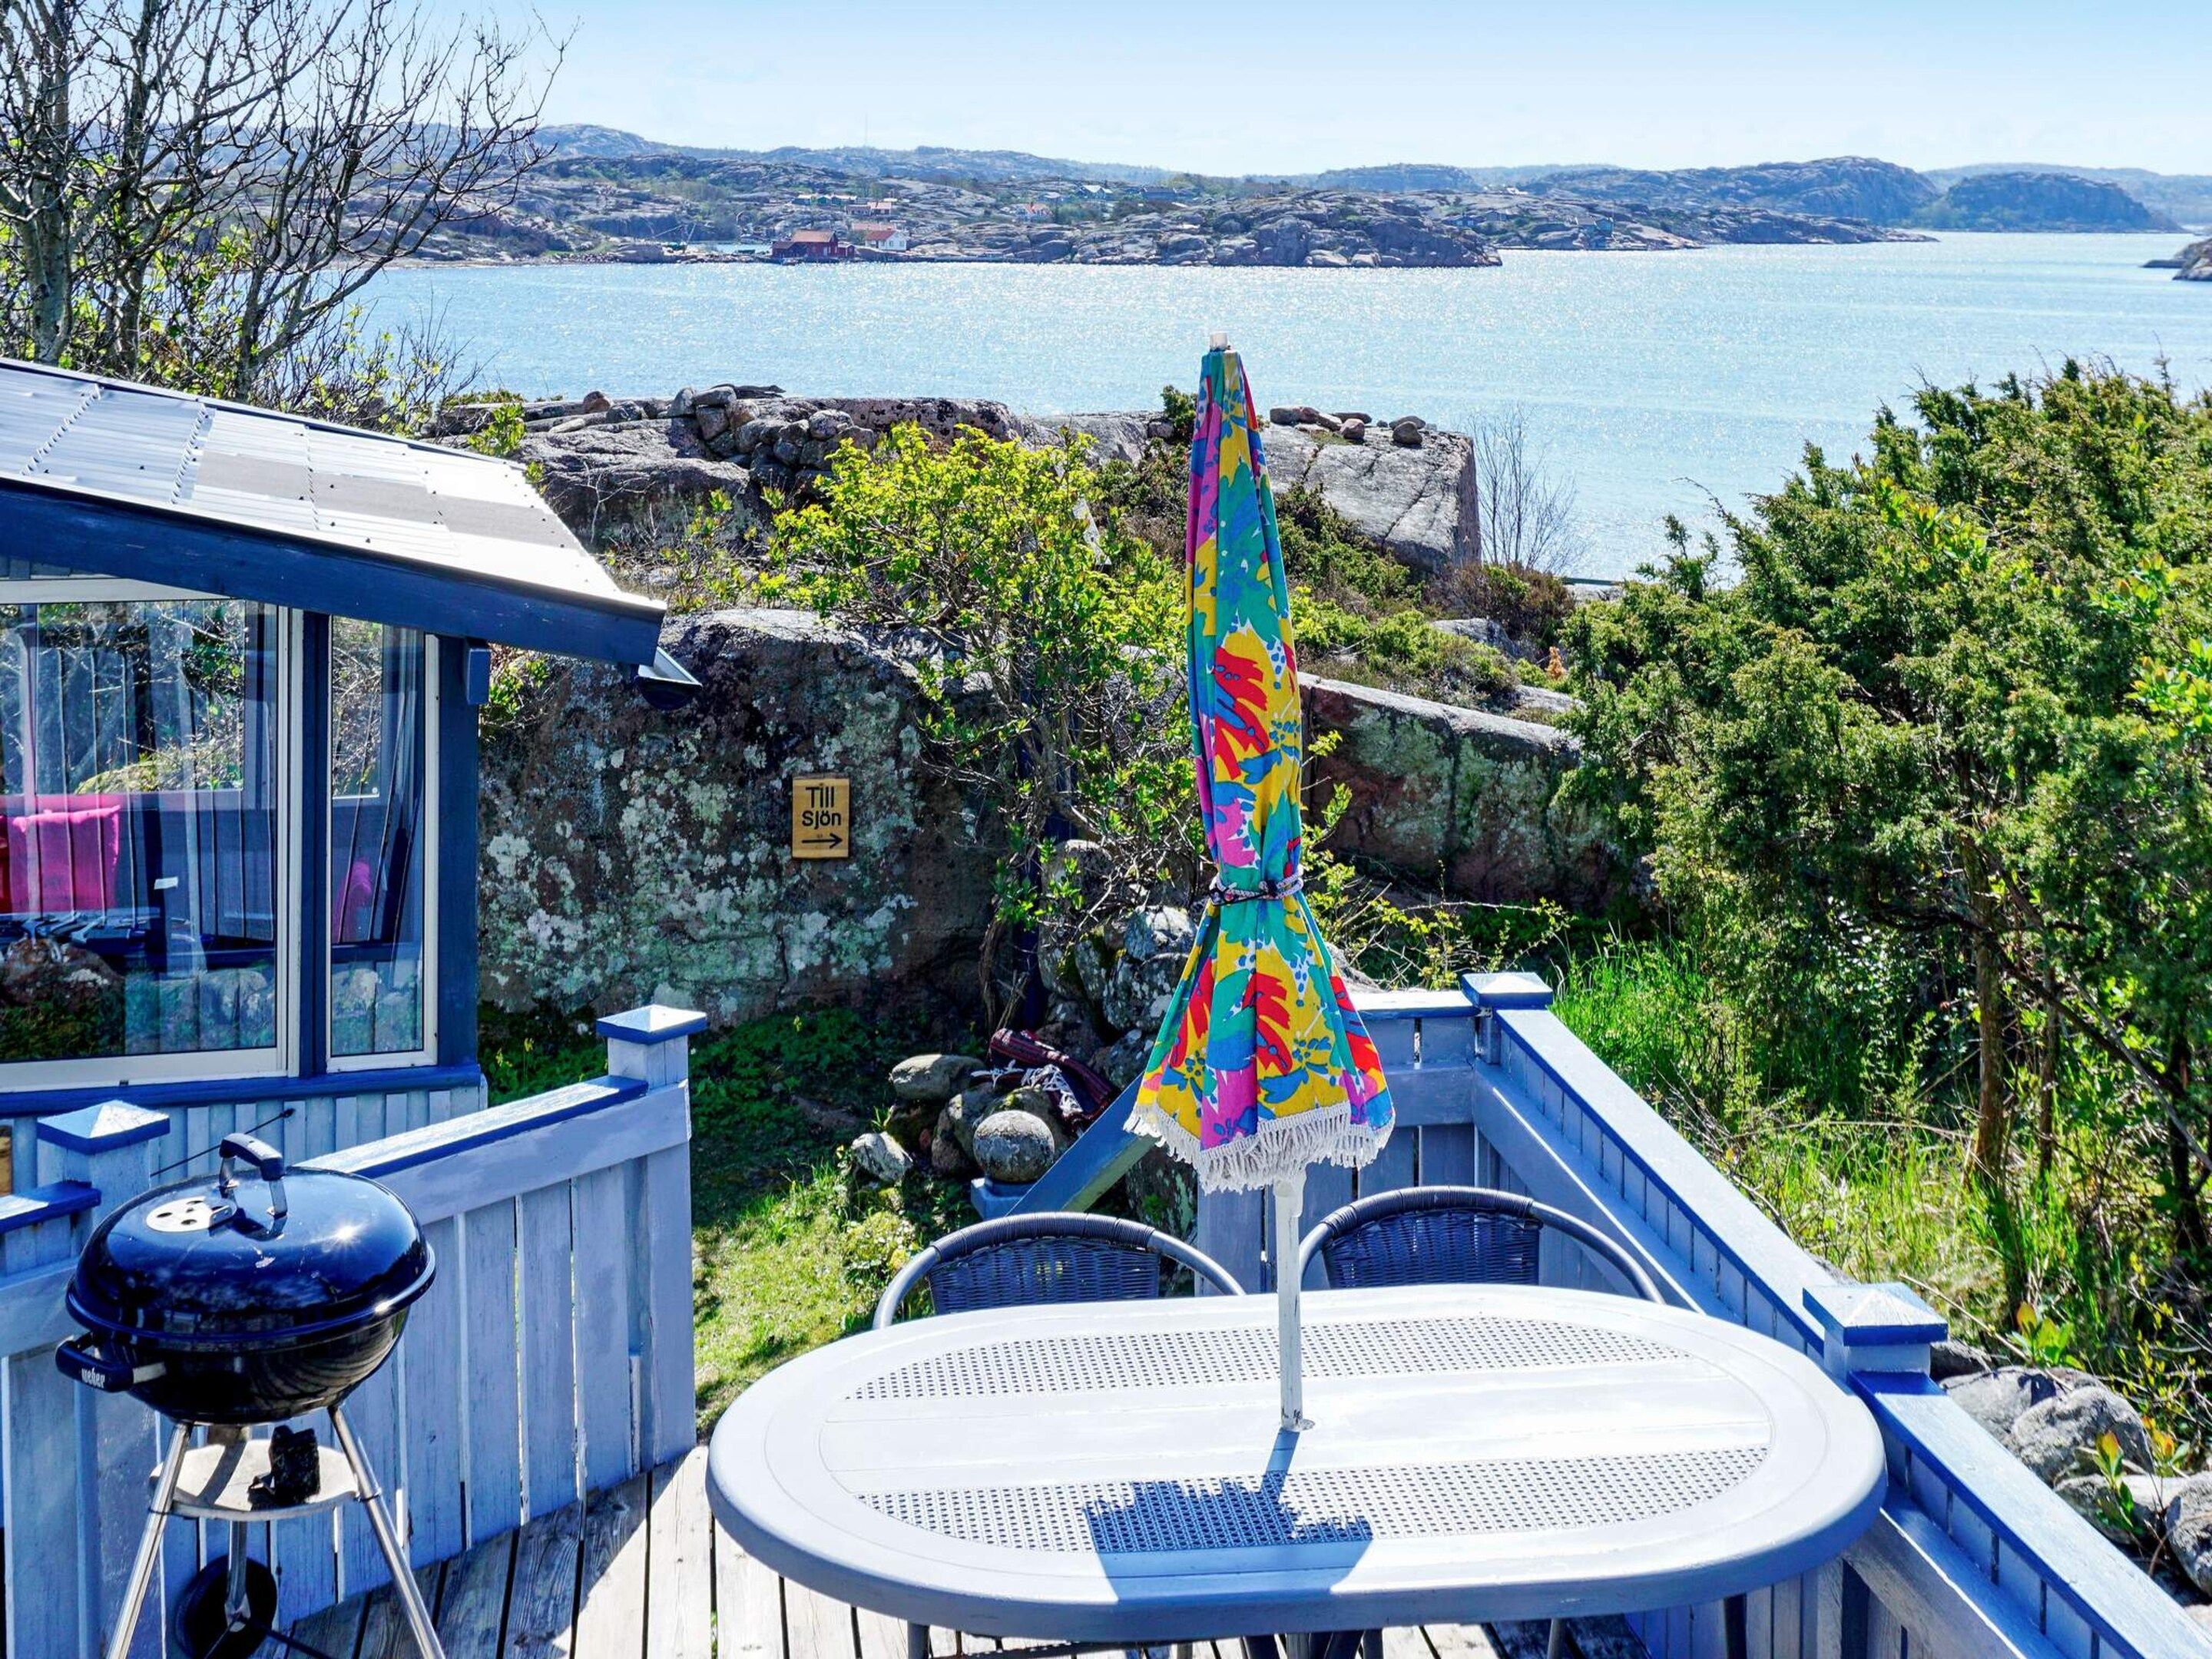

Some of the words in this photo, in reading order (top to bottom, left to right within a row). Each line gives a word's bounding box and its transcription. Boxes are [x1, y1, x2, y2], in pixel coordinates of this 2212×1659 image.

[805, 786, 835, 808] Till
[802, 810, 841, 830] Sjön
[81, 1367, 105, 1389] weber
